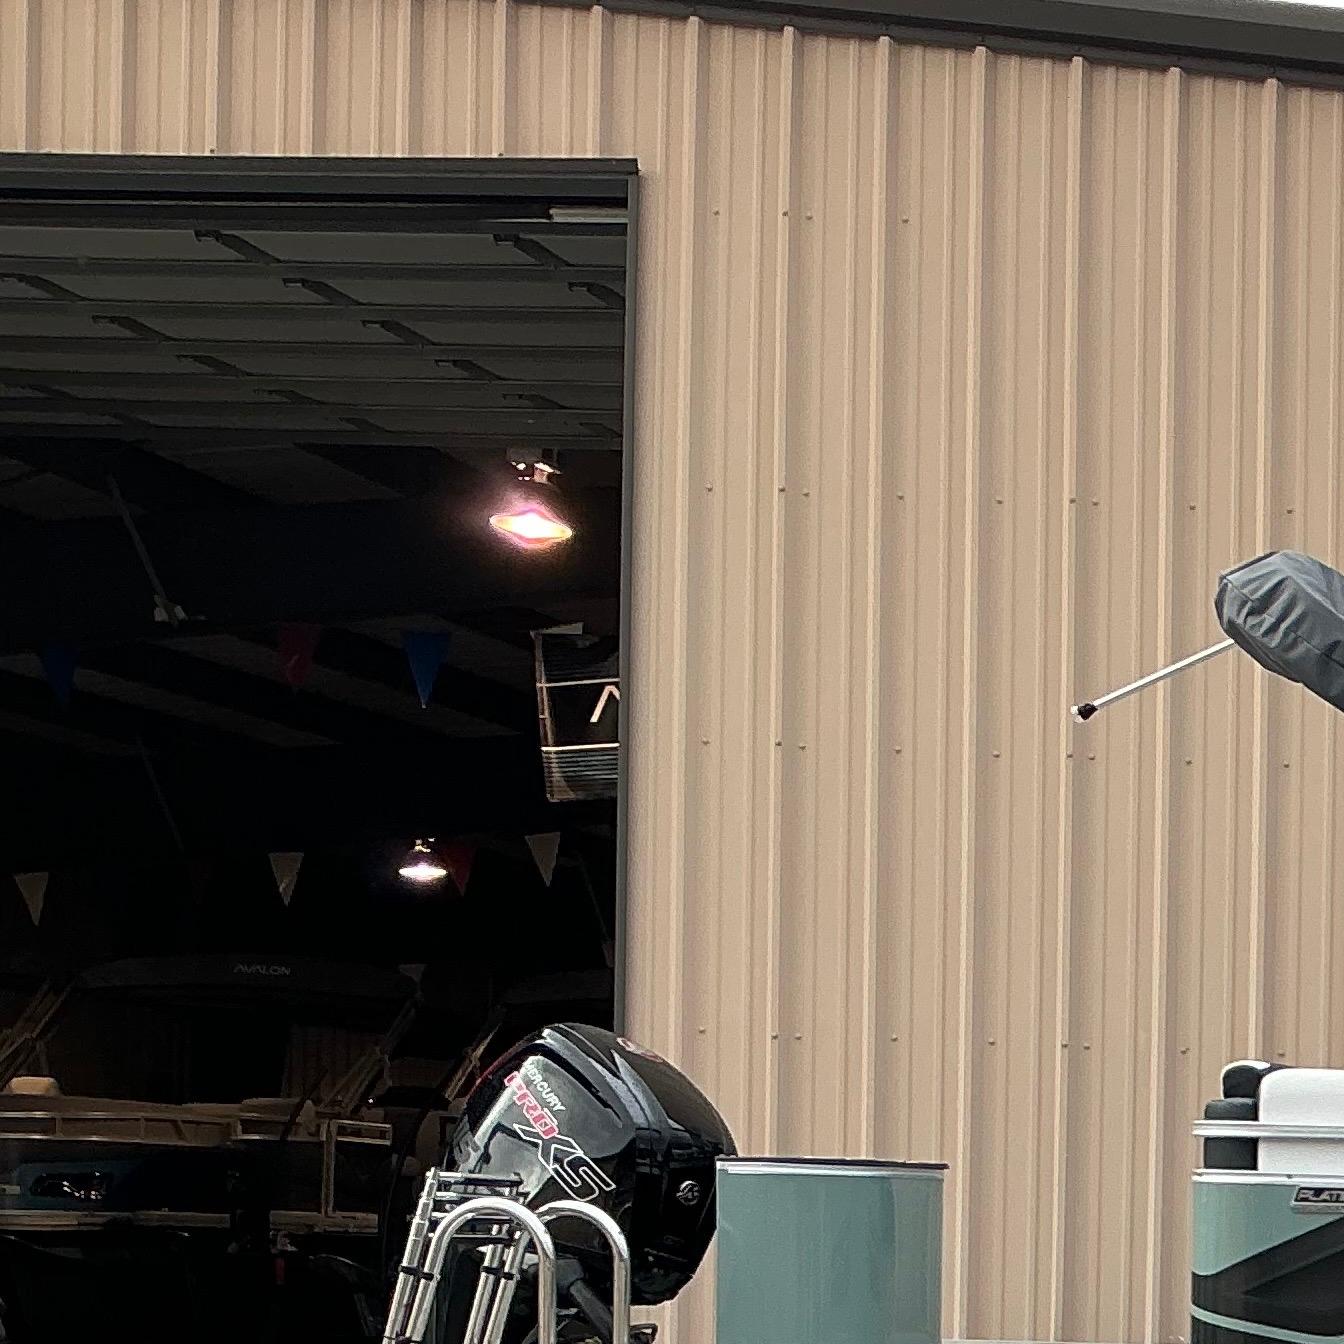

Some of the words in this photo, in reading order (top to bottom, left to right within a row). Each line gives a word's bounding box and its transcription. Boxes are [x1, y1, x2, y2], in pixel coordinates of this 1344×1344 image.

[503, 1070, 559, 1140] PRO
[522, 1062, 567, 1112] MERCURY
[512, 1122, 617, 1202] XS
